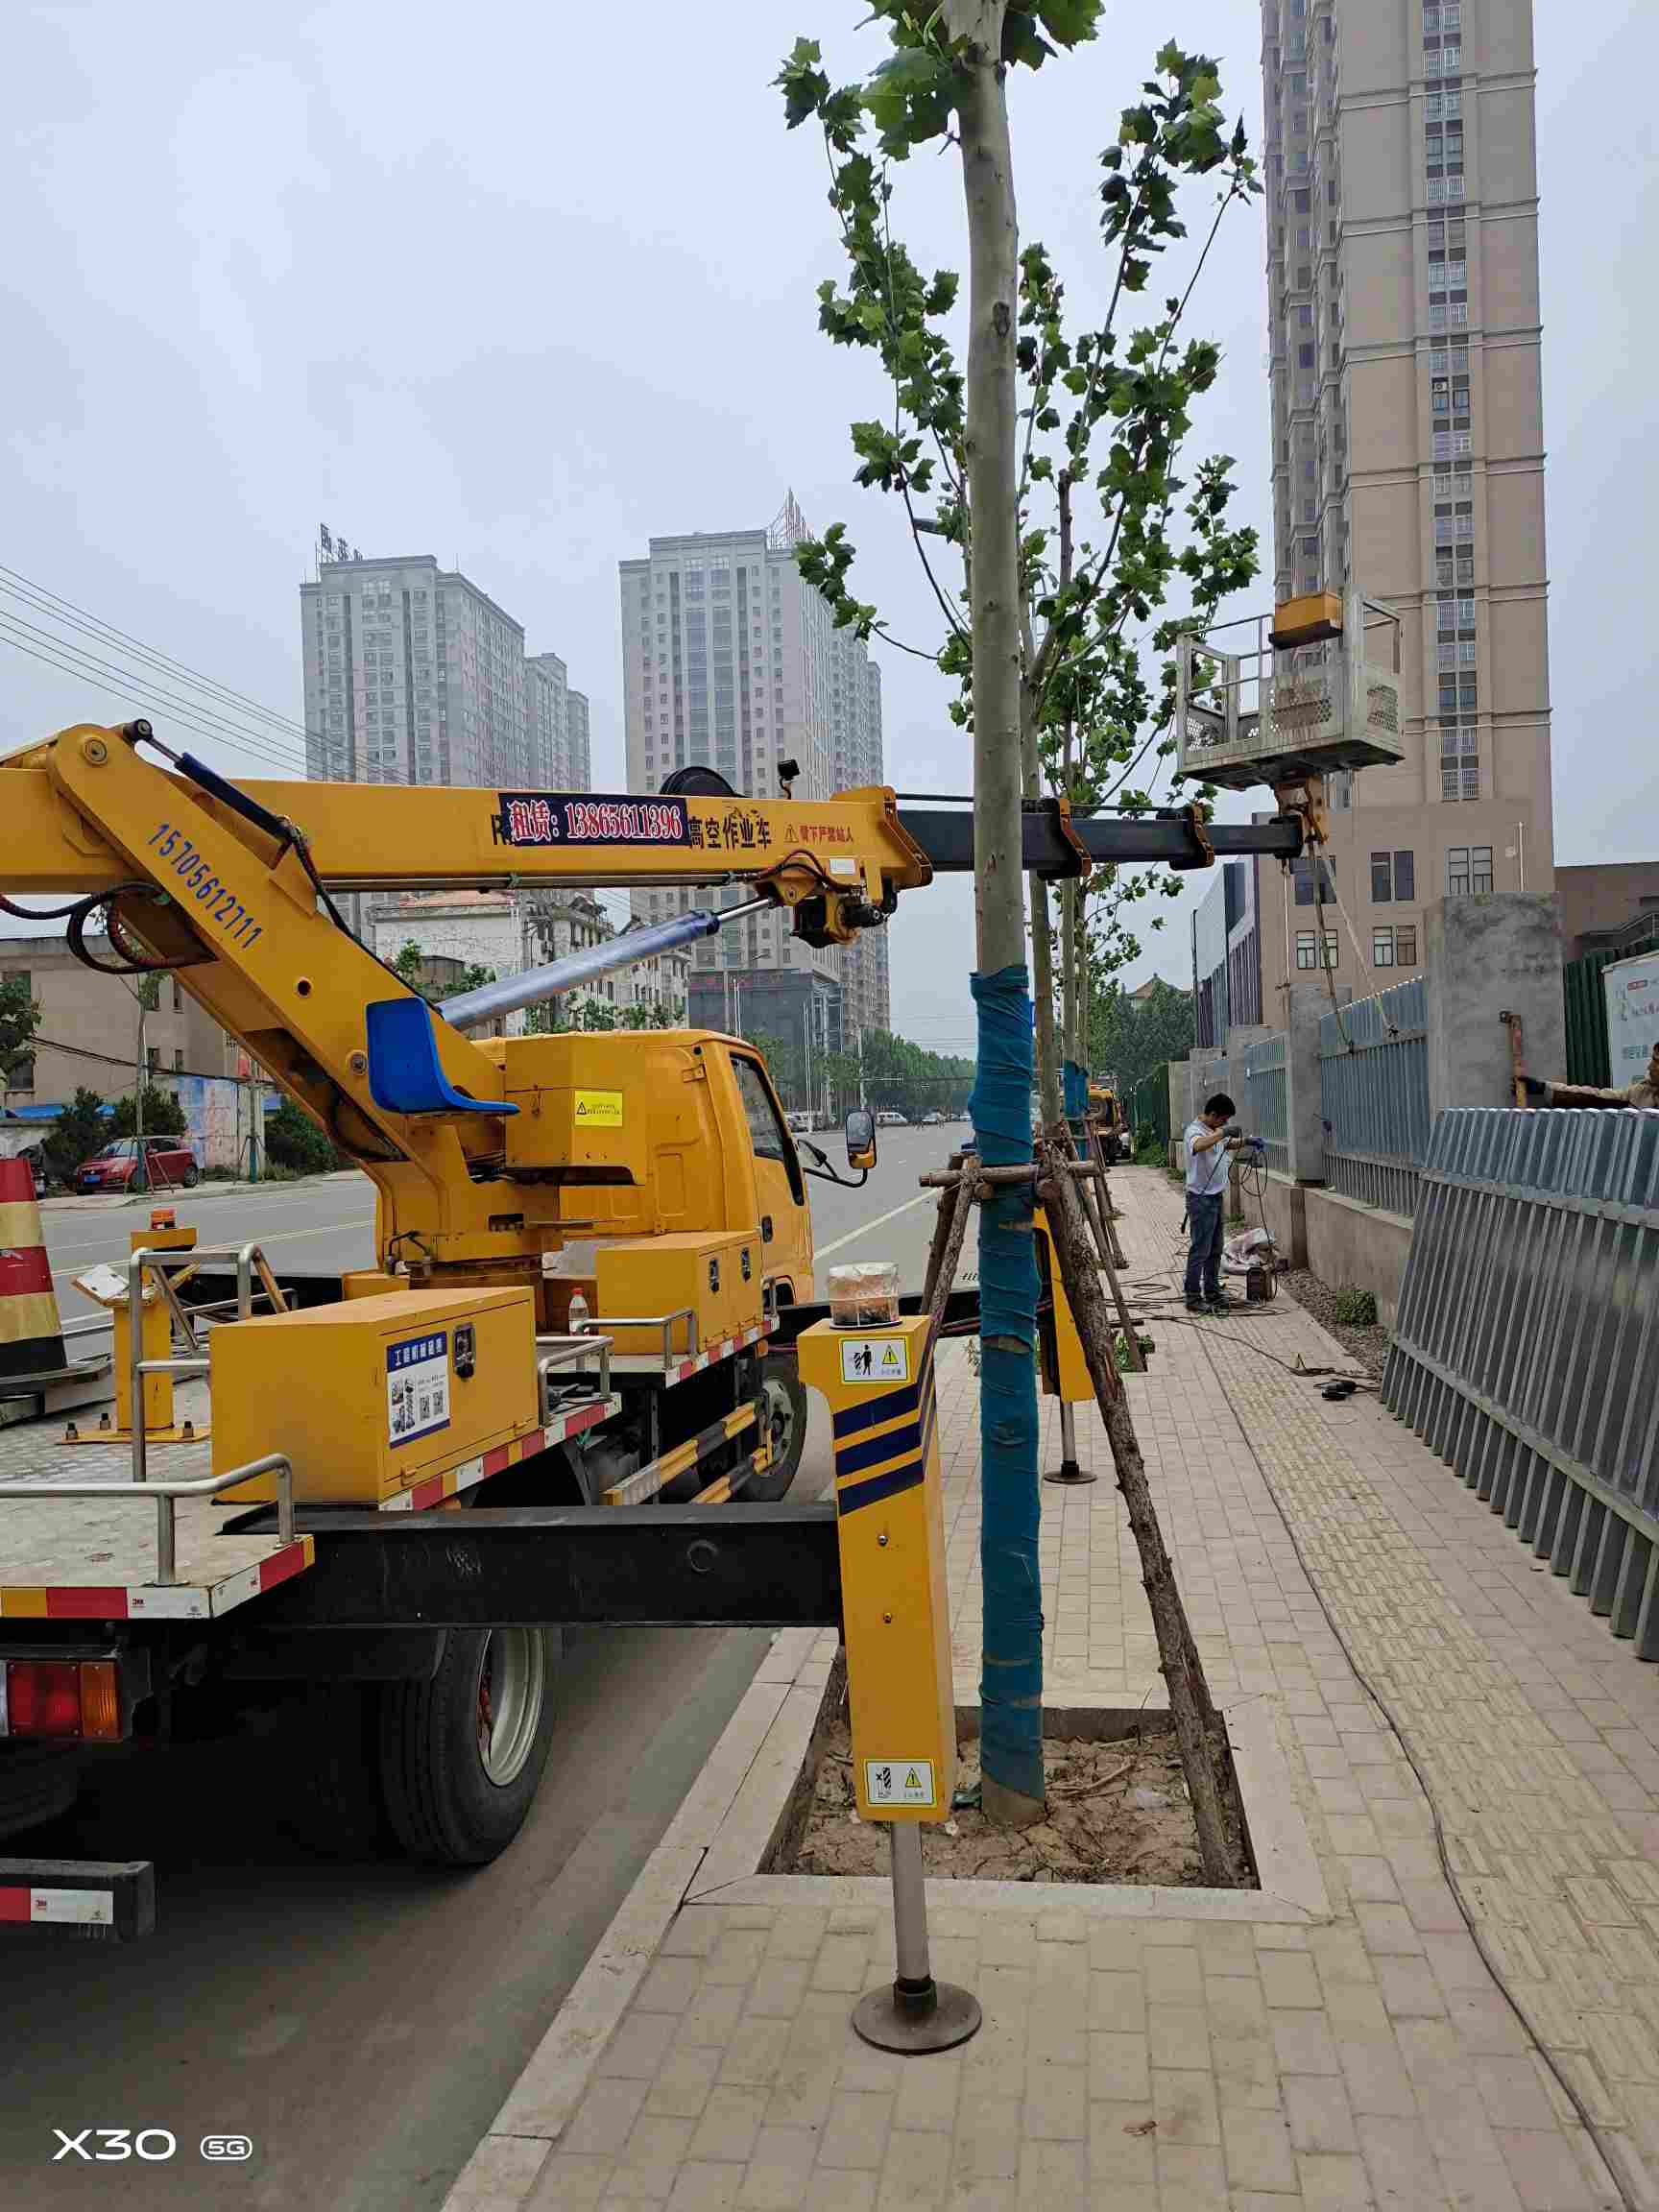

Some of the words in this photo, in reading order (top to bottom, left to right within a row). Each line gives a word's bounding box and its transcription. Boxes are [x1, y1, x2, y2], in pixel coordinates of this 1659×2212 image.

[565, 803, 683, 839] 13865611396
[688, 816, 772, 850] 高空作业车
[148, 823, 262, 949] 15705612711
